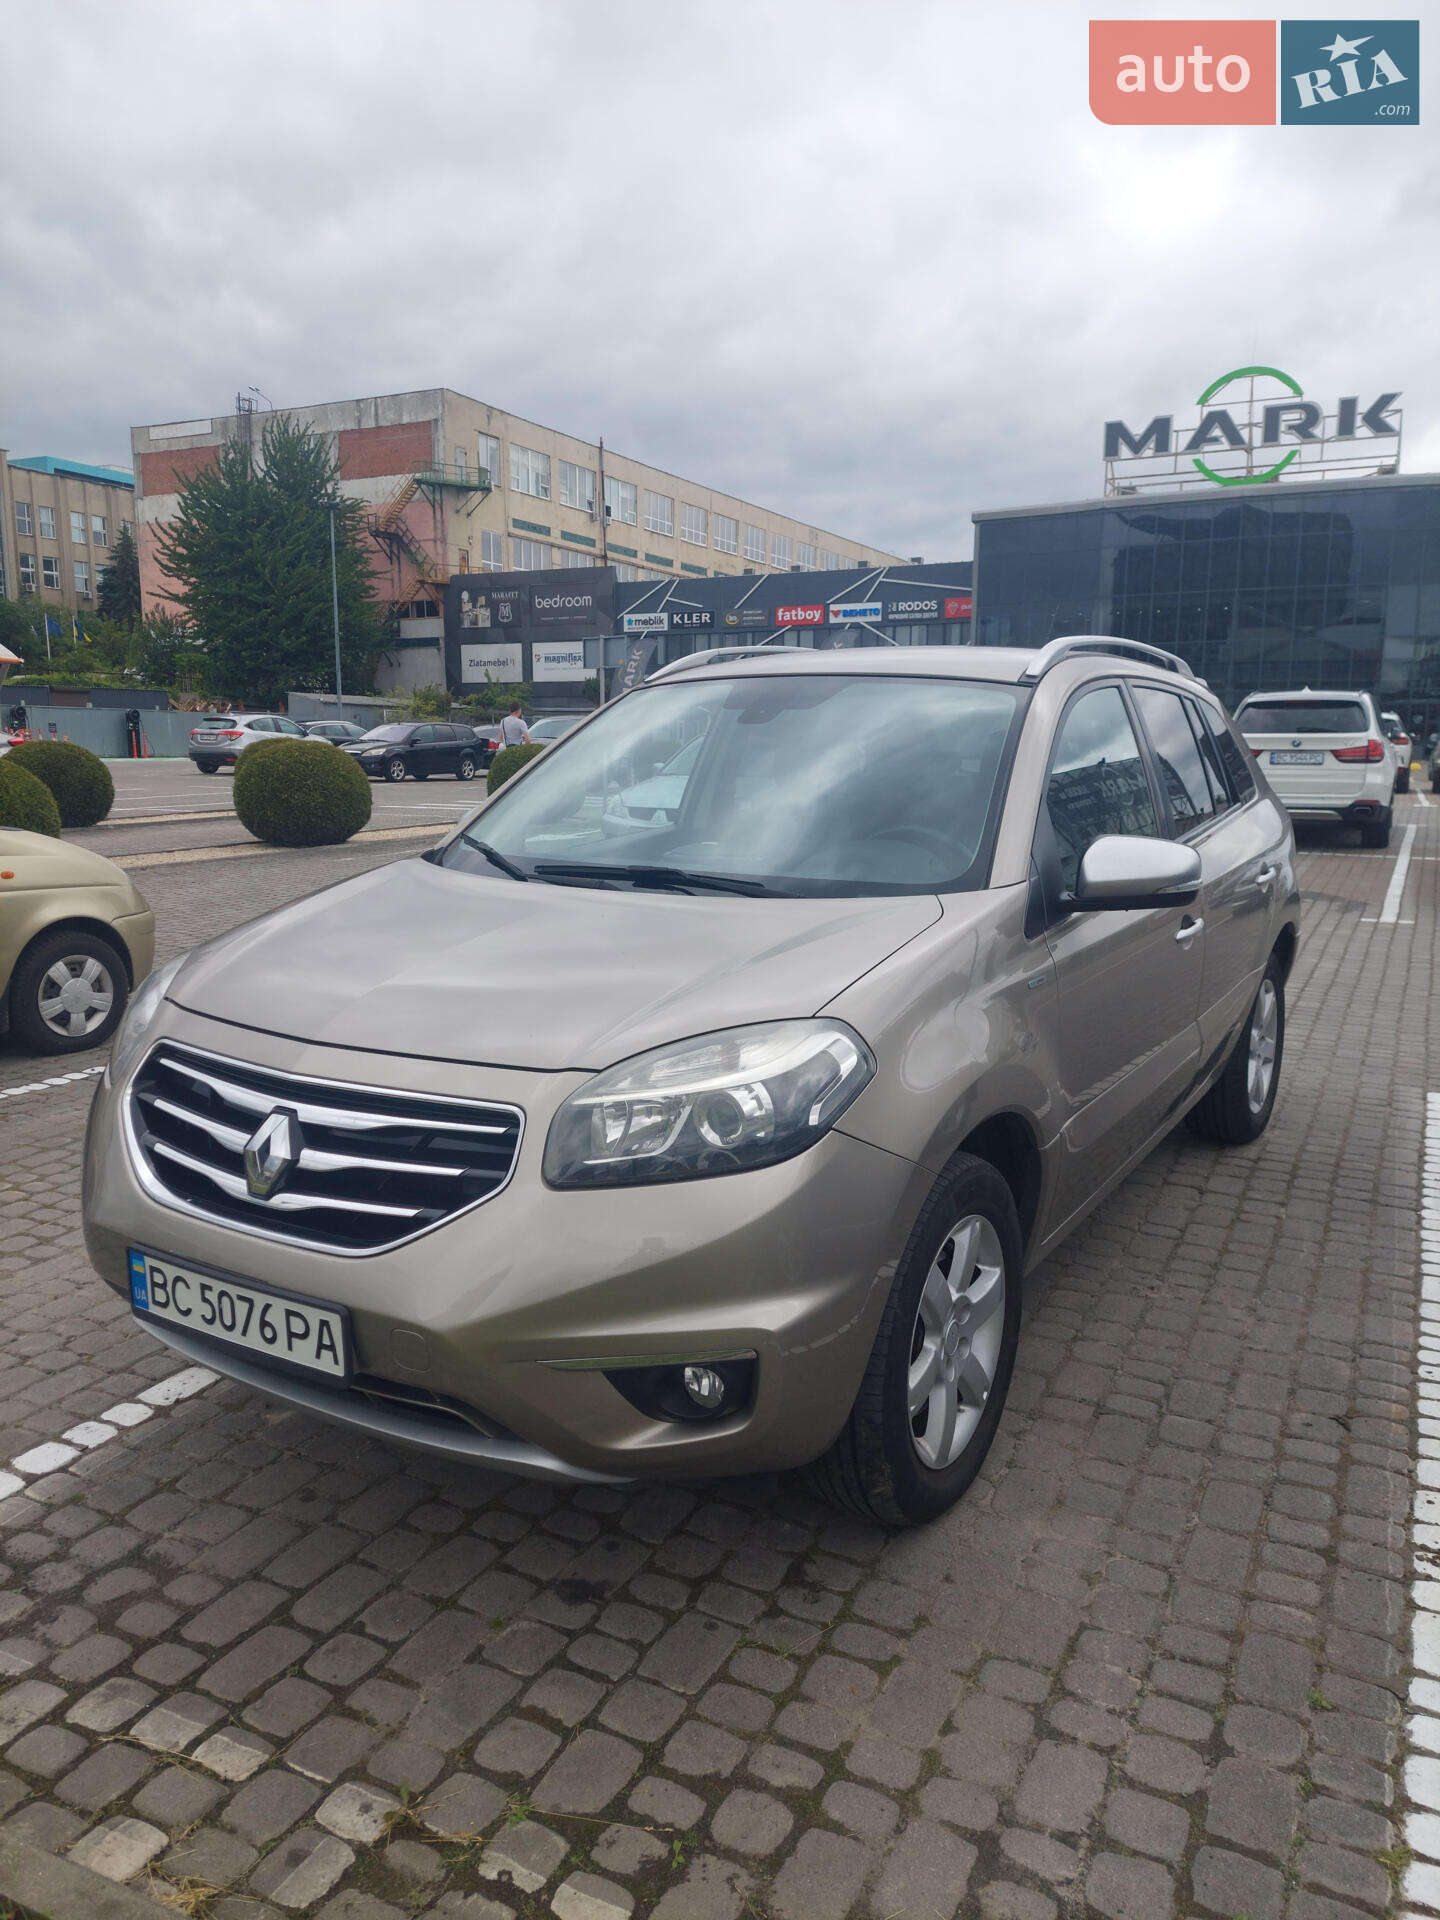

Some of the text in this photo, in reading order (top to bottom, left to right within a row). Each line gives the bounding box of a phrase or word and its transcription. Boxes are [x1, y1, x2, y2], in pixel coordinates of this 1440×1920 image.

[1103, 391, 1404, 462] MARK
[534, 594, 592, 609] bedroom
[898, 600, 938, 611] RODOS
[634, 616, 664, 627] meblik
[673, 612, 711, 624] KLER
[777, 607, 822, 622] fatboy
[622, 649, 642, 694] ARK
[133, 1286, 148, 1301] UA
